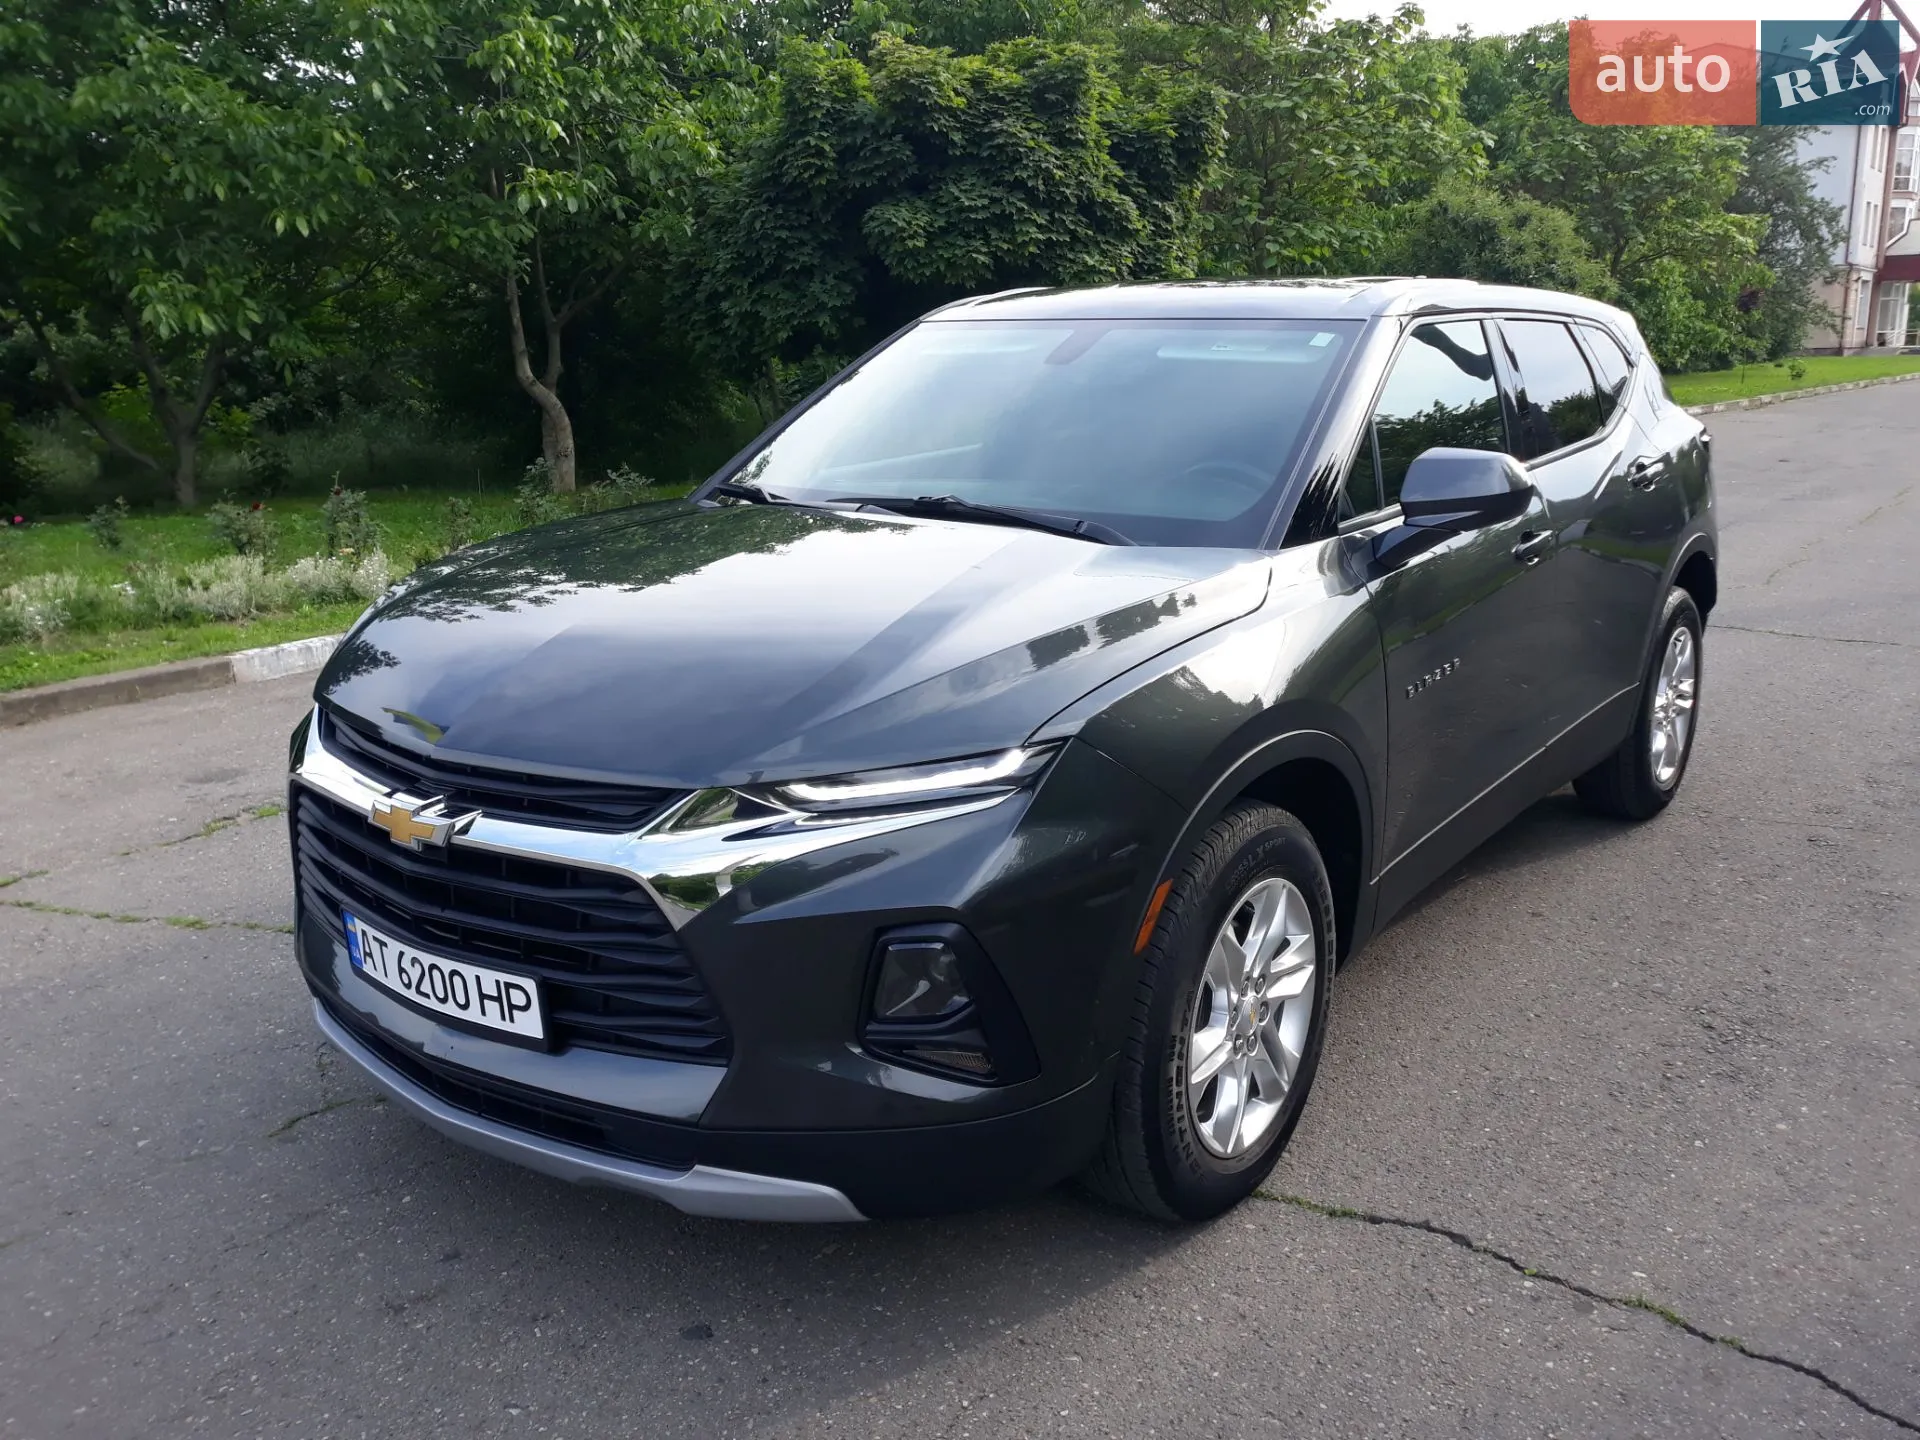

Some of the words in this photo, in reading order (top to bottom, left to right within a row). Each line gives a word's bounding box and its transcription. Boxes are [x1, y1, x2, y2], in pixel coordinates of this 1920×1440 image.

[361, 928, 388, 979] AT
[397, 950, 471, 1011] 6200
[475, 974, 532, 1024] HP
